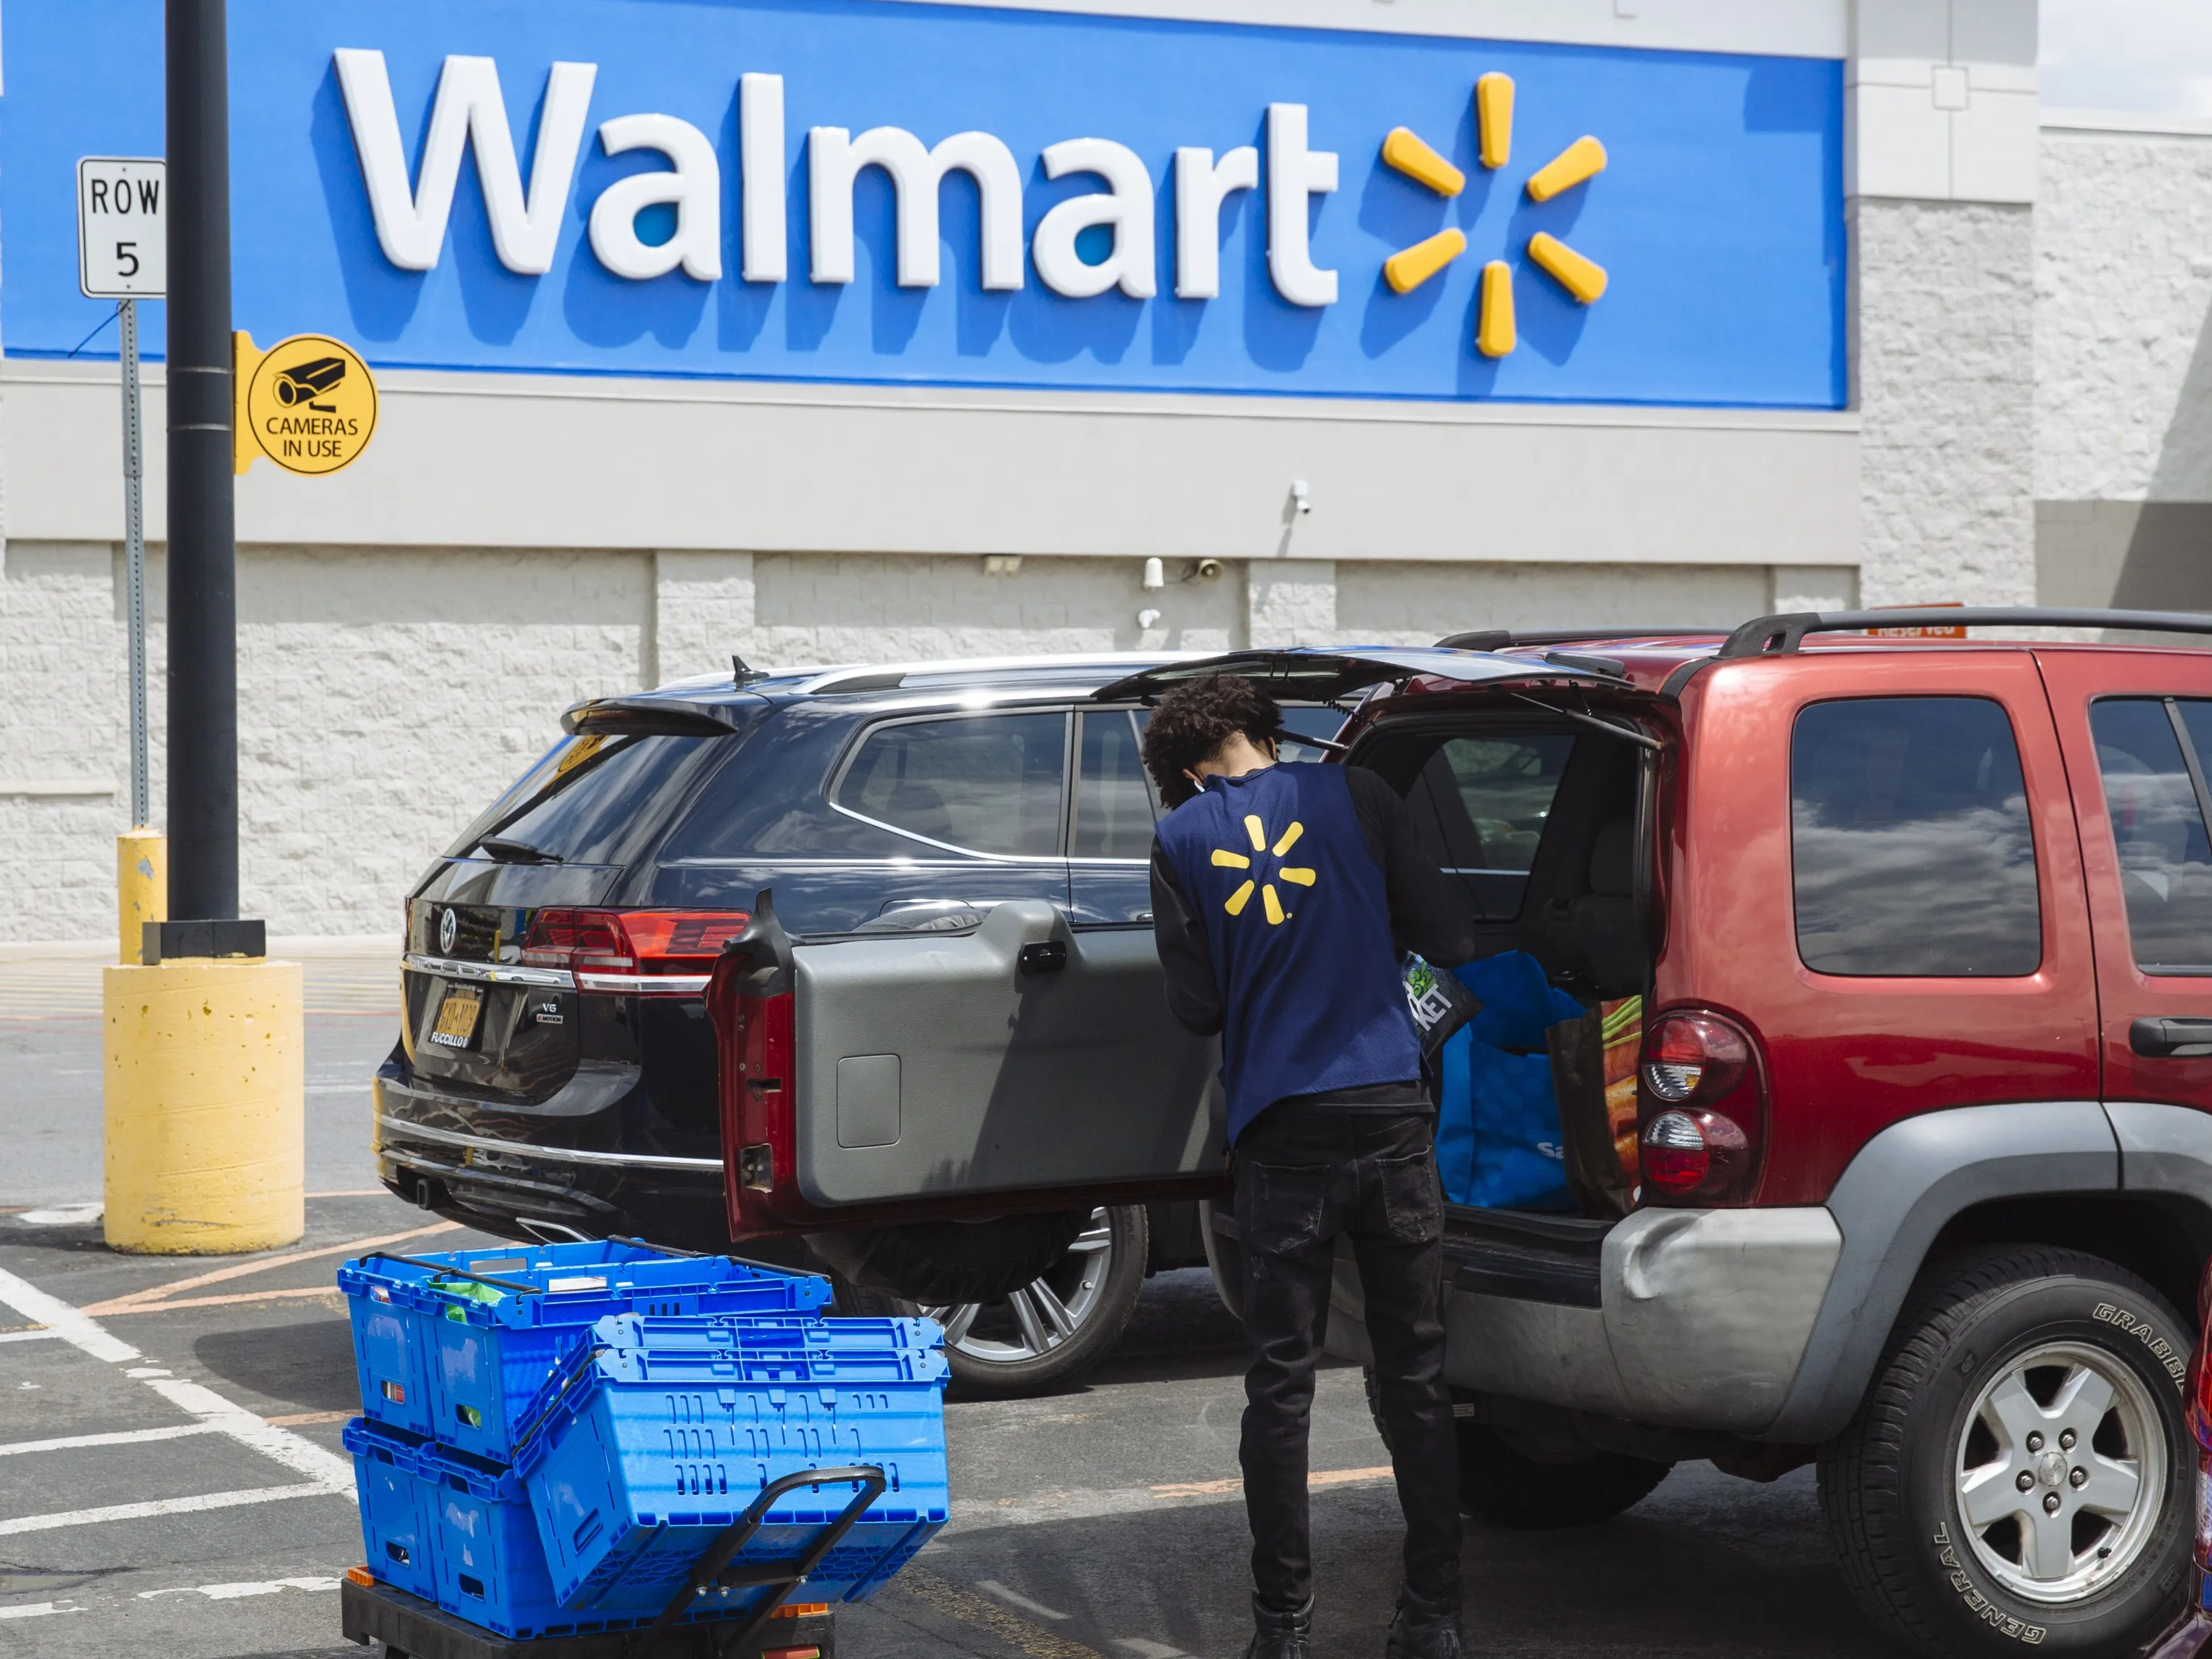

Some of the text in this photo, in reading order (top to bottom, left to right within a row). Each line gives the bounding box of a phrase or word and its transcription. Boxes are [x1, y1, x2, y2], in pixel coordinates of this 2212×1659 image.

[91, 178, 160, 215] ROW
[333, 48, 1339, 308] Walmart
[116, 241, 140, 278] 5
[265, 417, 359, 437] CAMERAS
[283, 439, 342, 458] IN USE
[542, 1003, 557, 1013] V6
[431, 1031, 464, 1047] FUCCILLO
[2092, 1302, 2185, 1397] GRABB
[1933, 1521, 2047, 1644] GENERAL
